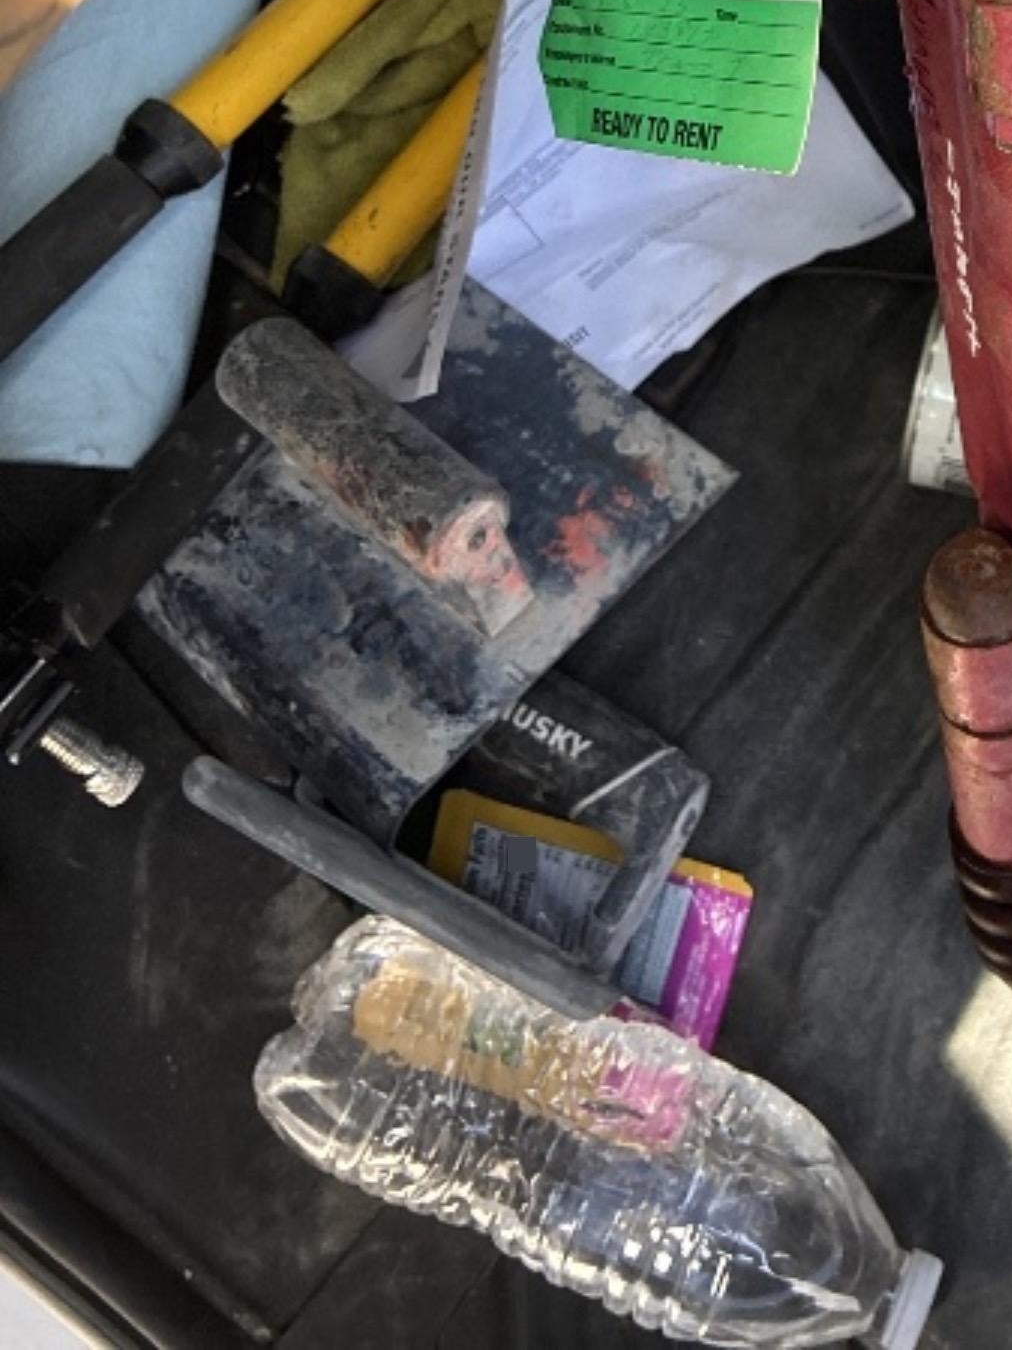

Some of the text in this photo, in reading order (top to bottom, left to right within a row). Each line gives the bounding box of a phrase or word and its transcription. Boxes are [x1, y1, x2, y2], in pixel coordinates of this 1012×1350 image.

[591, 107, 723, 150] READY TO RENT
